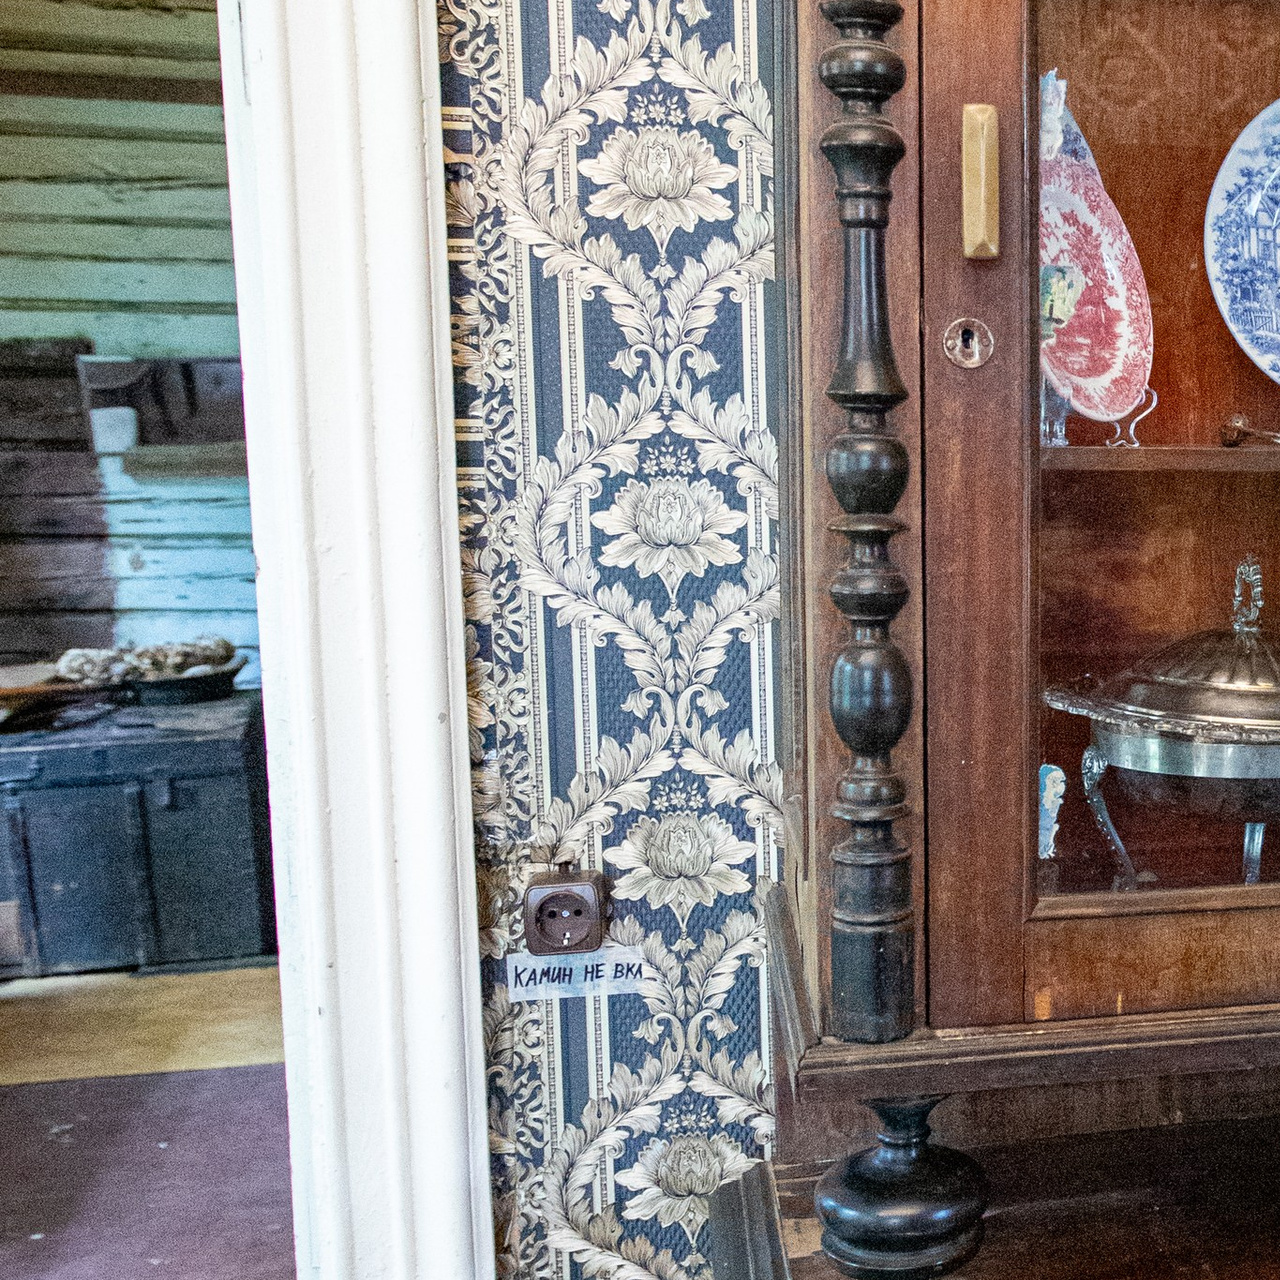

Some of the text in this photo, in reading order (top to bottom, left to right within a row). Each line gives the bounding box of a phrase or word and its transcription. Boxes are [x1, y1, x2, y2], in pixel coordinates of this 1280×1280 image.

[514, 962, 643, 988] КАМИН НЕ ВКЛ
